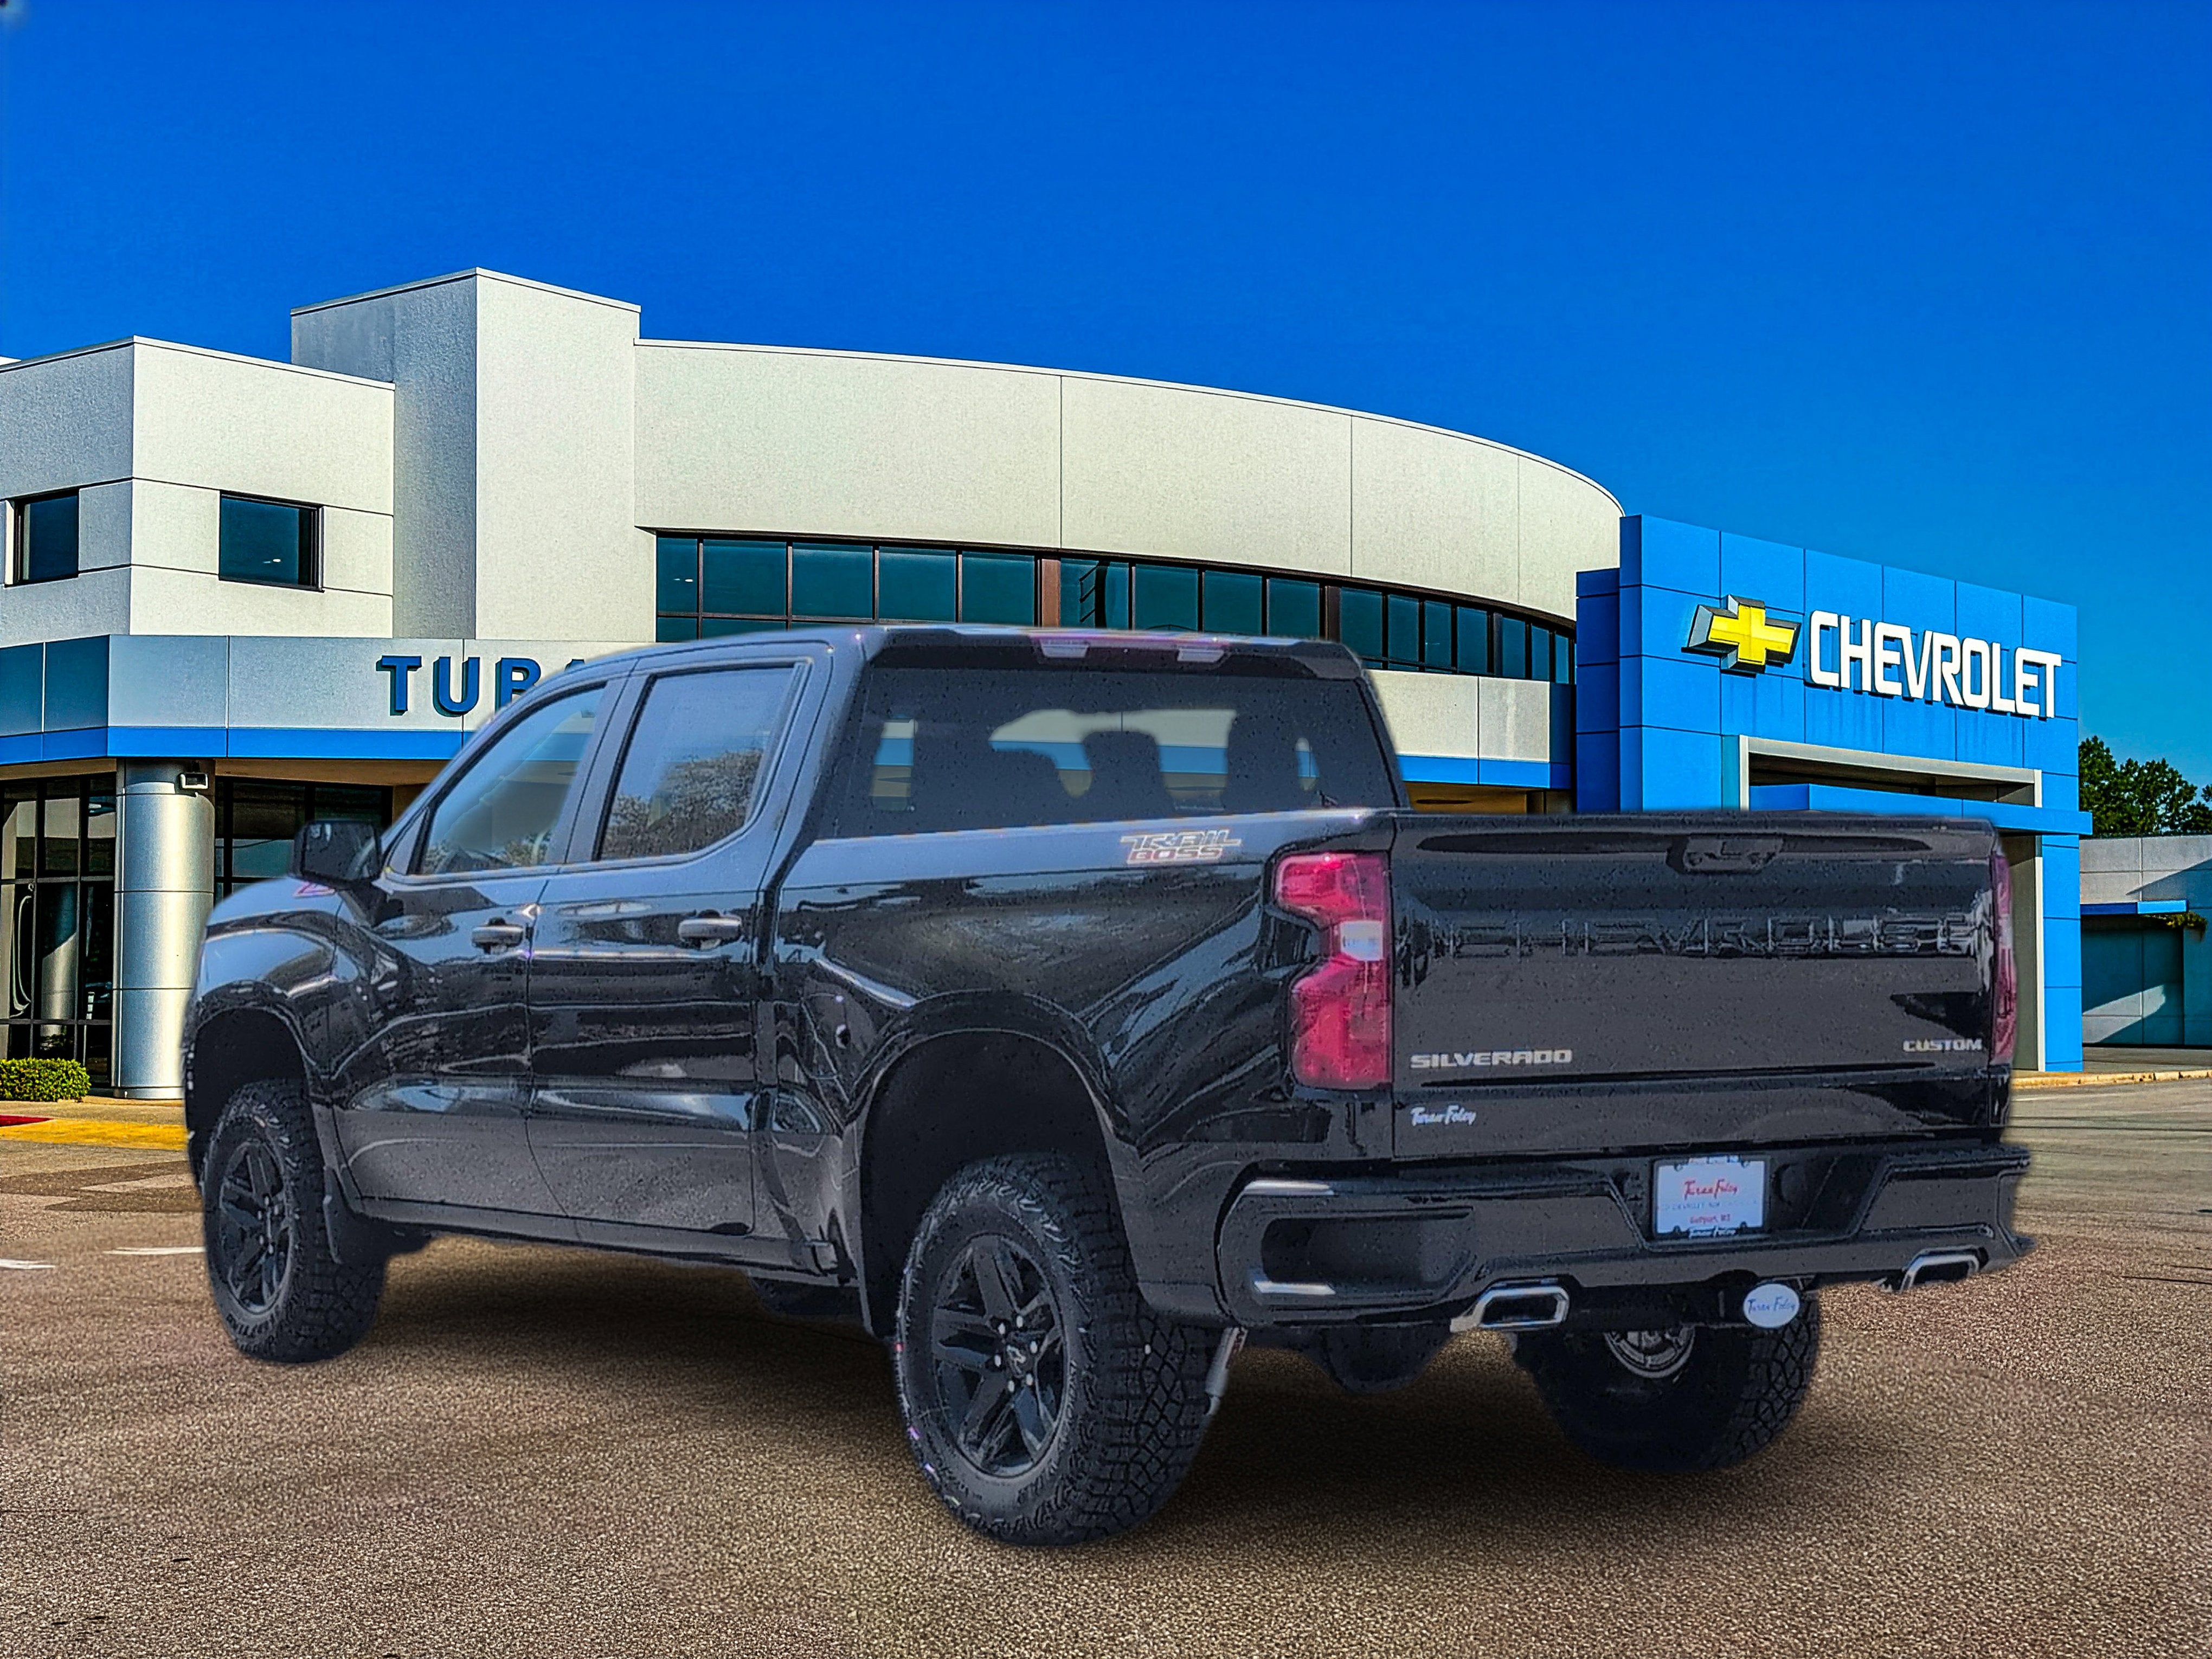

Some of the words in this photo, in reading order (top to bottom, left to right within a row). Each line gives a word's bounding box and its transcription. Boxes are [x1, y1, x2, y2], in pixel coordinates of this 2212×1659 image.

[1810, 609, 2062, 718] CHEVROLET
[376, 655, 585, 717] TUR
[1120, 828, 1242, 850] TRAIL
[1126, 846, 1224, 865] BOSS
[1902, 1038, 1983, 1052] CUSTOM
[1410, 1049, 1572, 1069] SILVERADO
